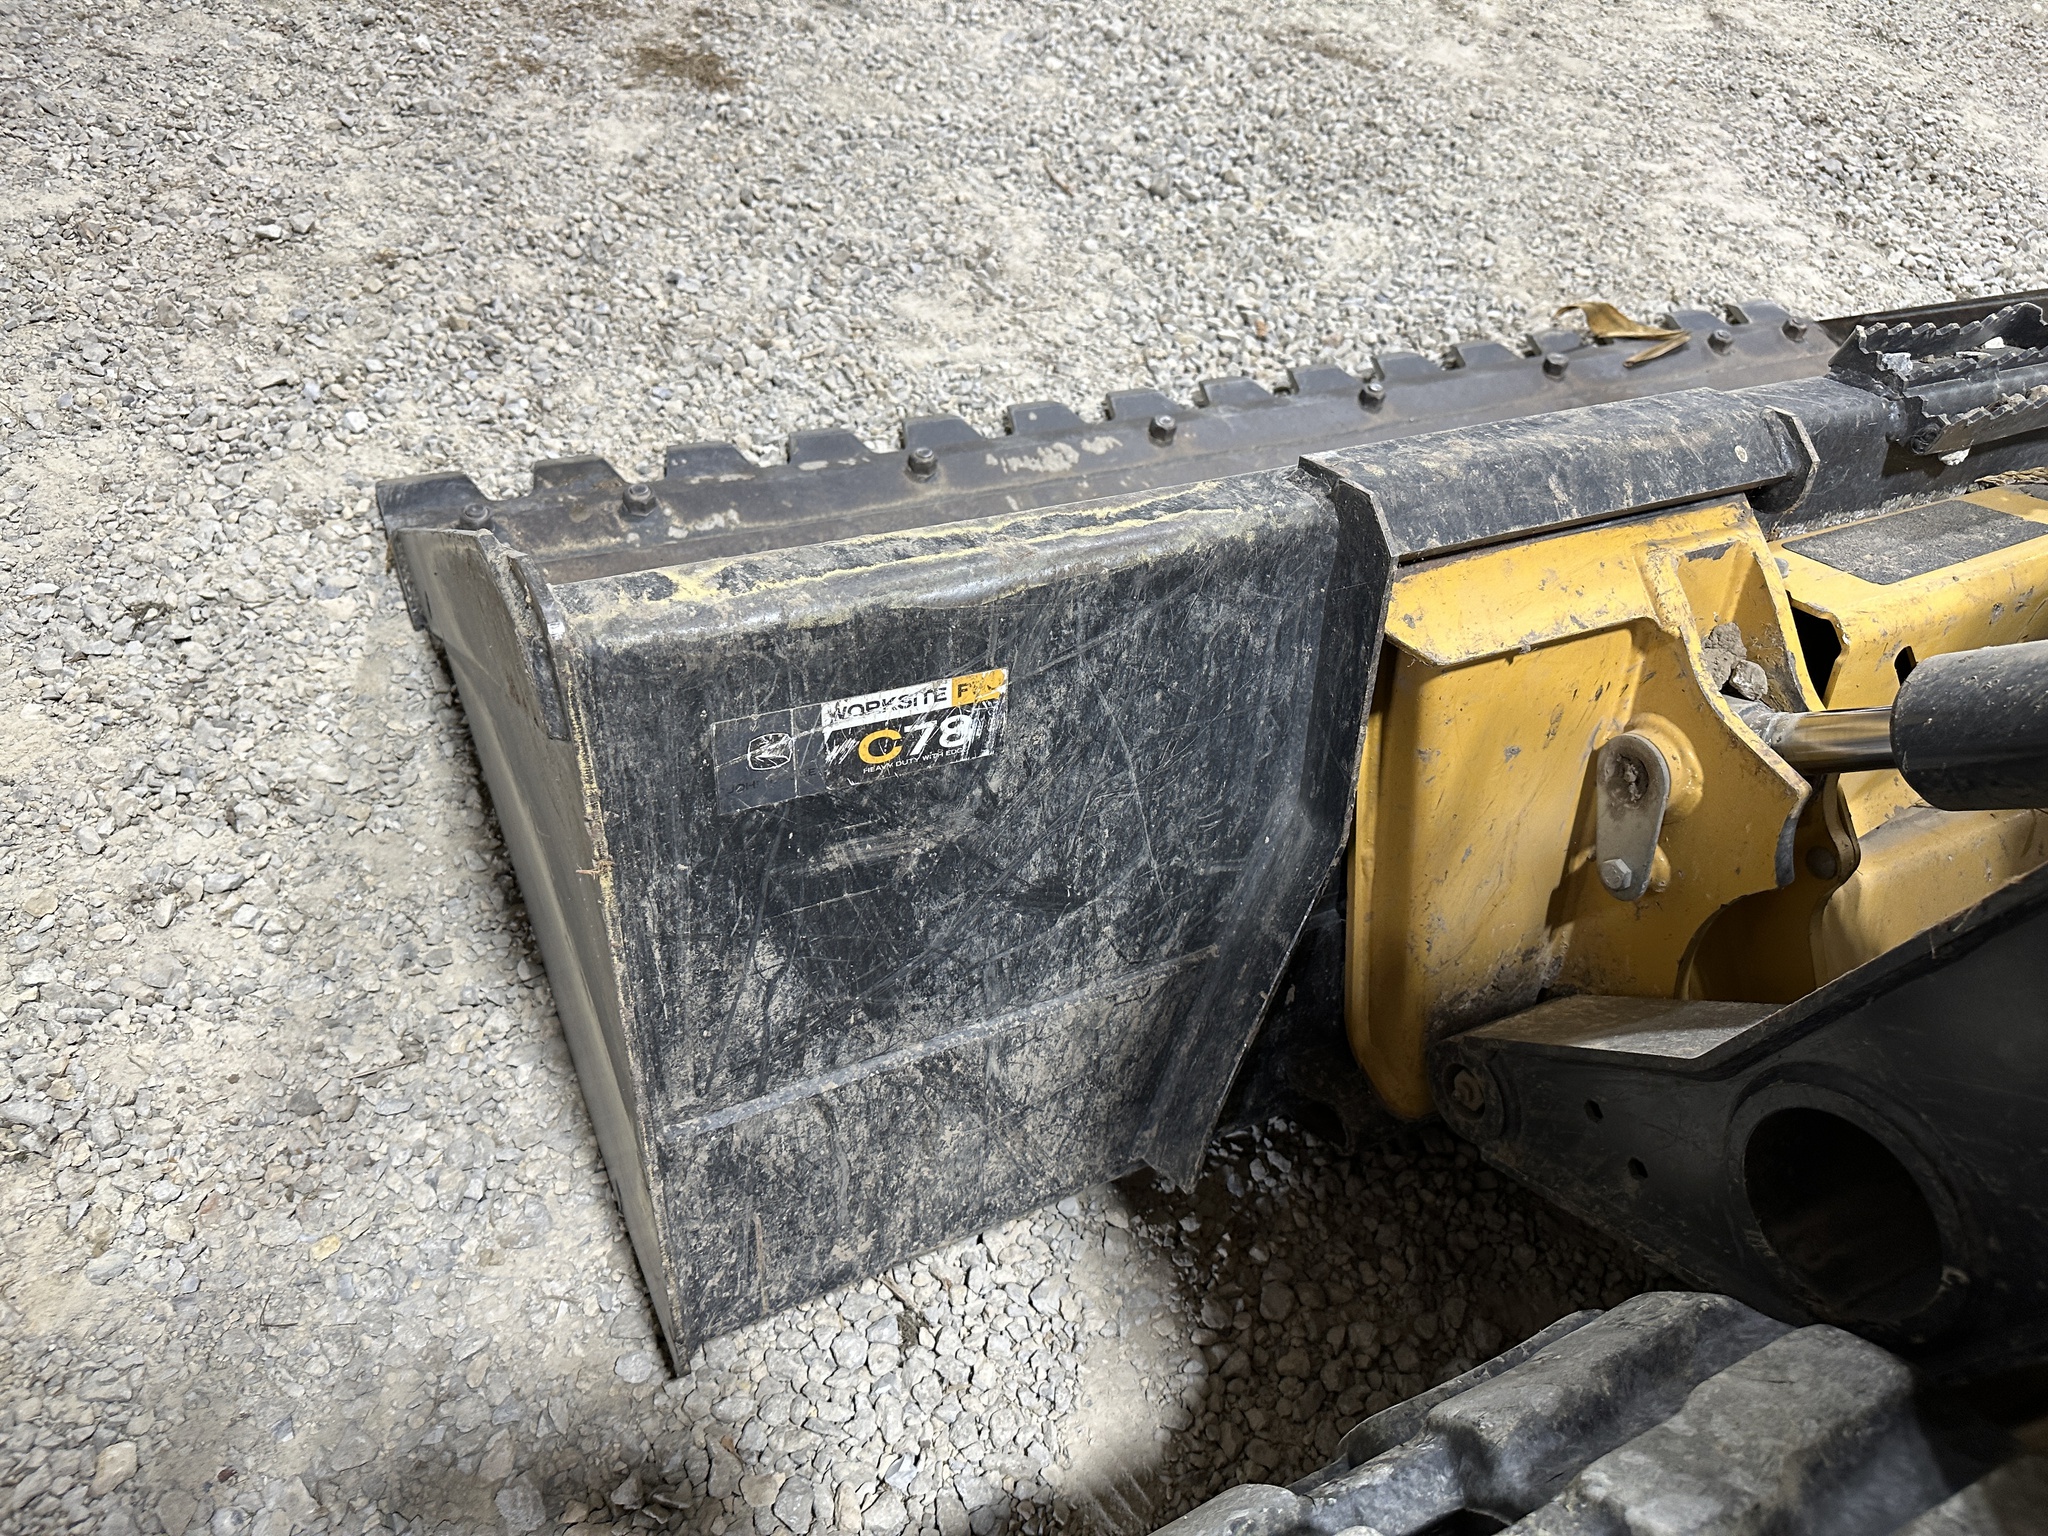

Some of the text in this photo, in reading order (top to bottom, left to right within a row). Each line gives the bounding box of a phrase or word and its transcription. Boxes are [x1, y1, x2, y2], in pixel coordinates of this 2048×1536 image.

[829, 686, 947, 720] WORKSITE
[859, 714, 972, 764] C78
[863, 762, 894, 775] HEAVY
[895, 757, 920, 767] DUTY
[922, 752, 944, 762] WITH
